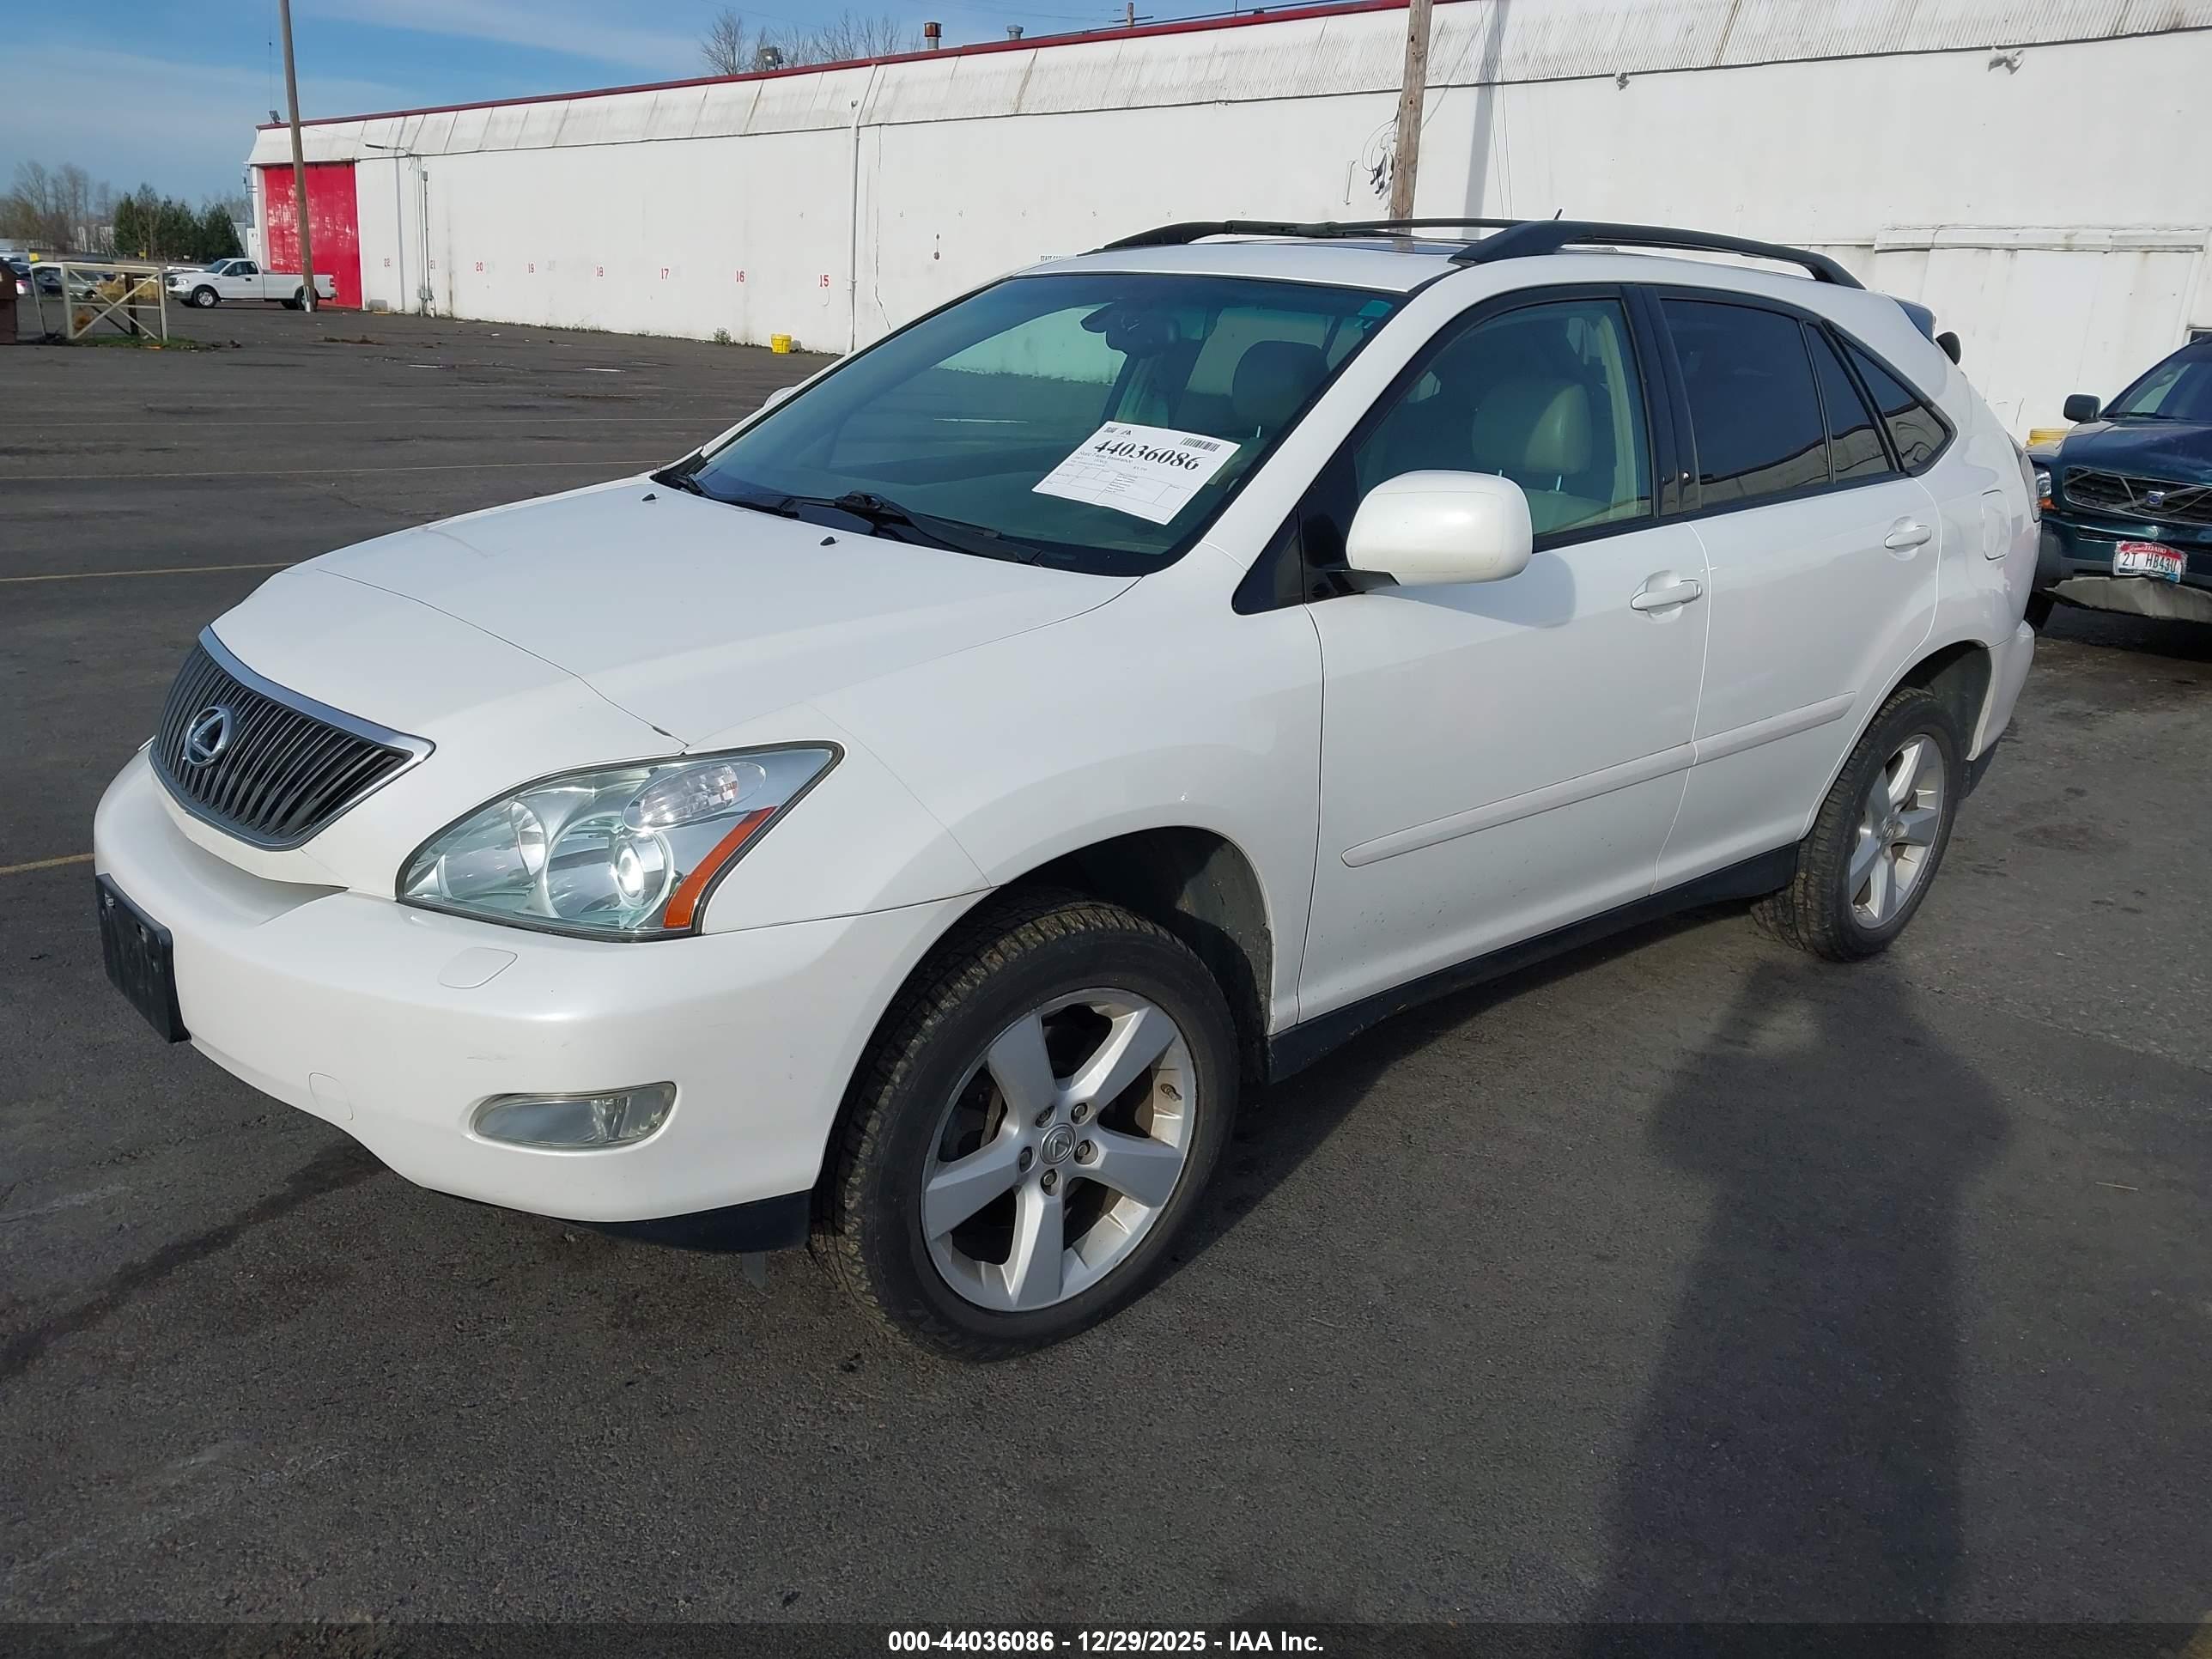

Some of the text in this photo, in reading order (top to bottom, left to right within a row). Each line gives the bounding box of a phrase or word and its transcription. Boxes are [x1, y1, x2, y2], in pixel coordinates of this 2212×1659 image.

[384, 258, 391, 267] 22
[429, 260, 436, 270] 21
[476, 262, 483, 271] 20
[528, 264, 535, 273] 19
[596, 266, 604, 277] 18
[660, 268, 670, 280] 17
[736, 270, 745, 283] 16
[819, 274, 830, 288] 15
[1094, 440, 1206, 471] 44036086
[2122, 552, 2178, 573] 2T HB43U
